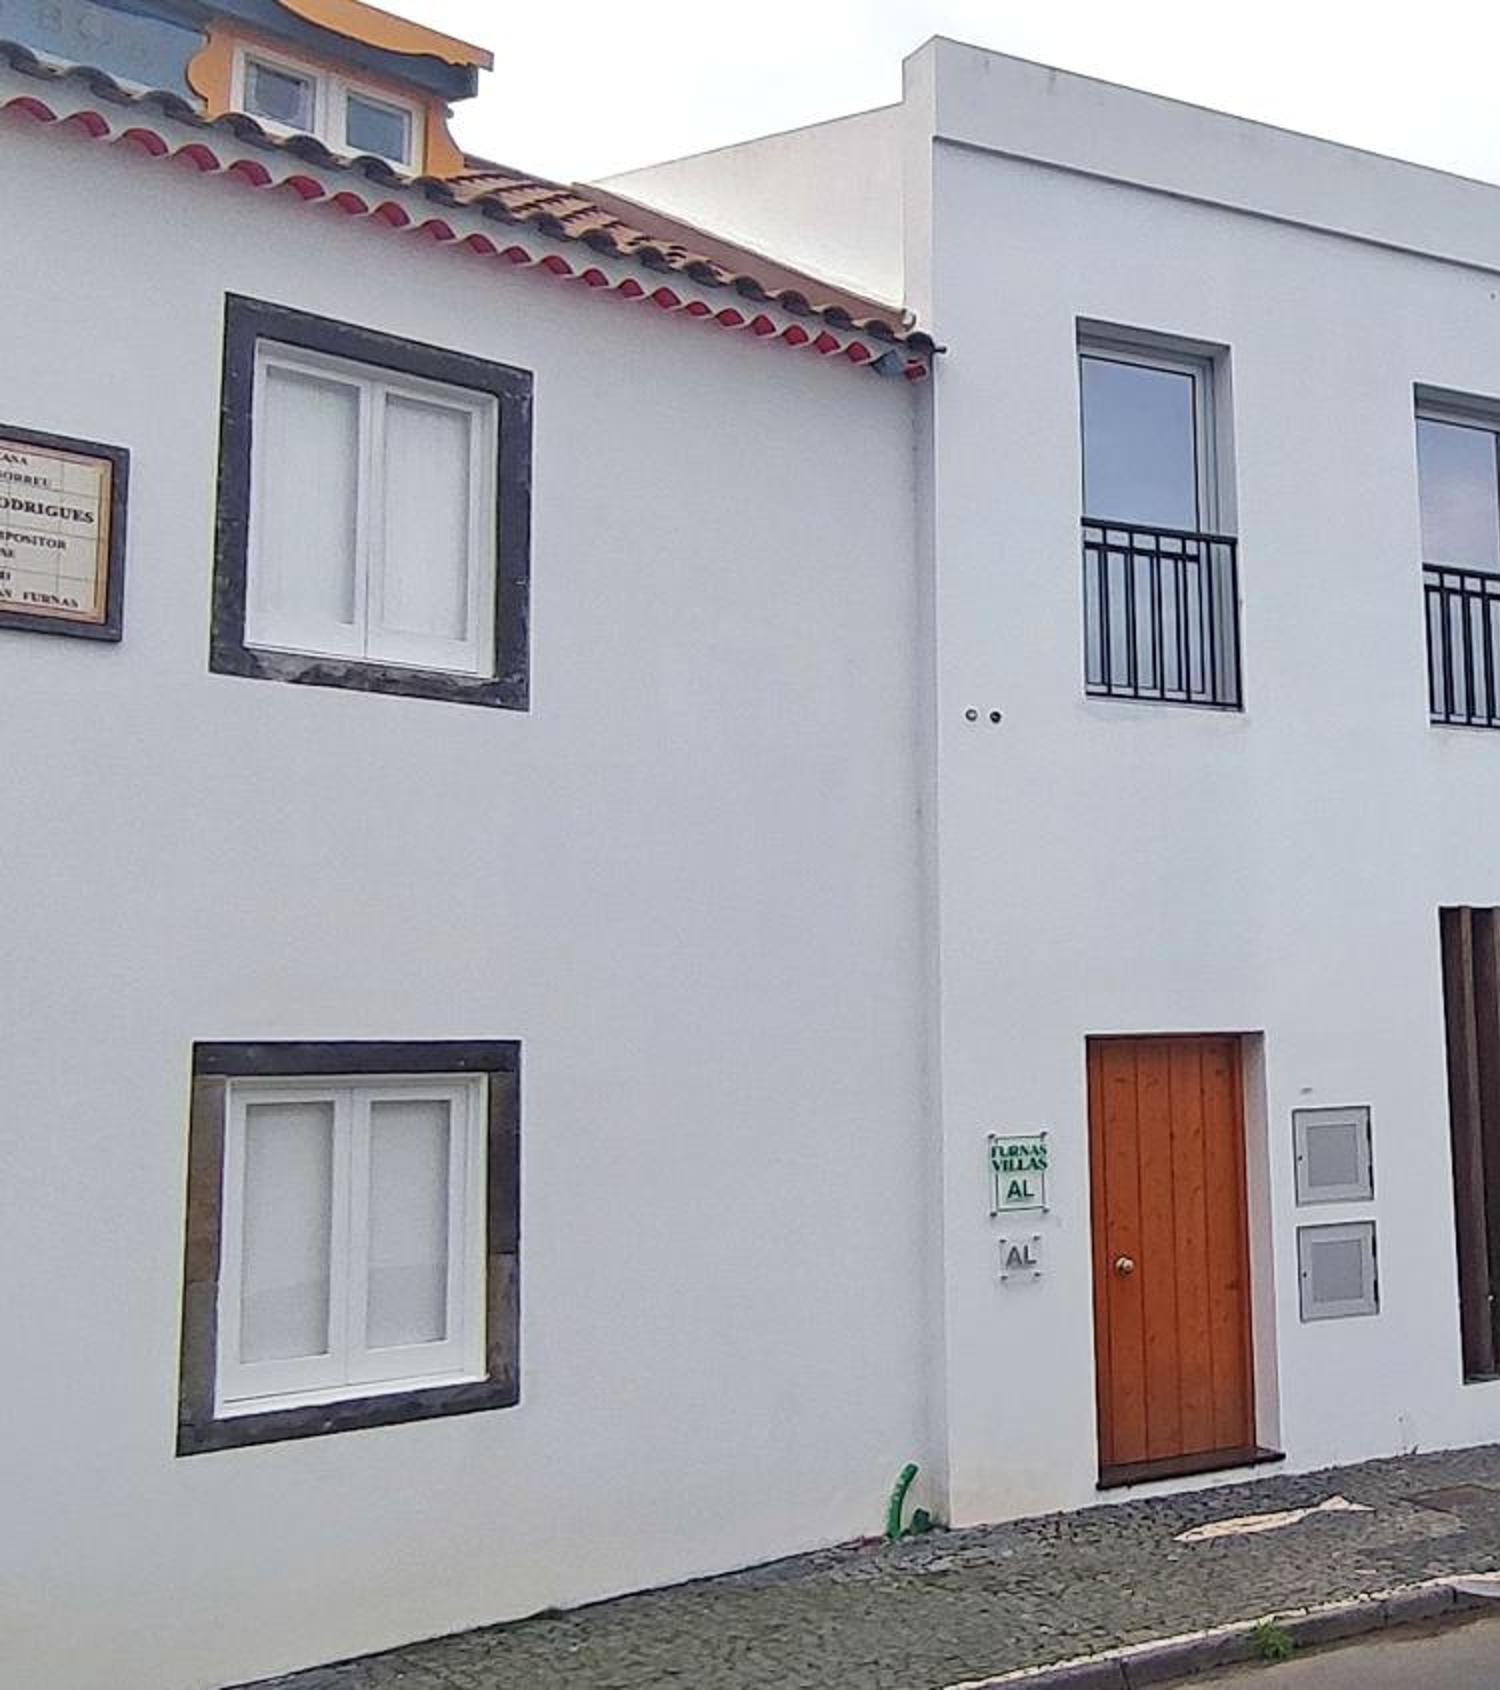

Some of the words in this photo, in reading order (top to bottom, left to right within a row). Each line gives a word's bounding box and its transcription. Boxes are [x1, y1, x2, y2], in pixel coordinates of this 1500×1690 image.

[0, 453, 28, 465] ASA
[991, 1157, 1049, 1172] VILLAS
[1007, 1179, 1035, 1199] AL
[1005, 1244, 1037, 1267] AL
